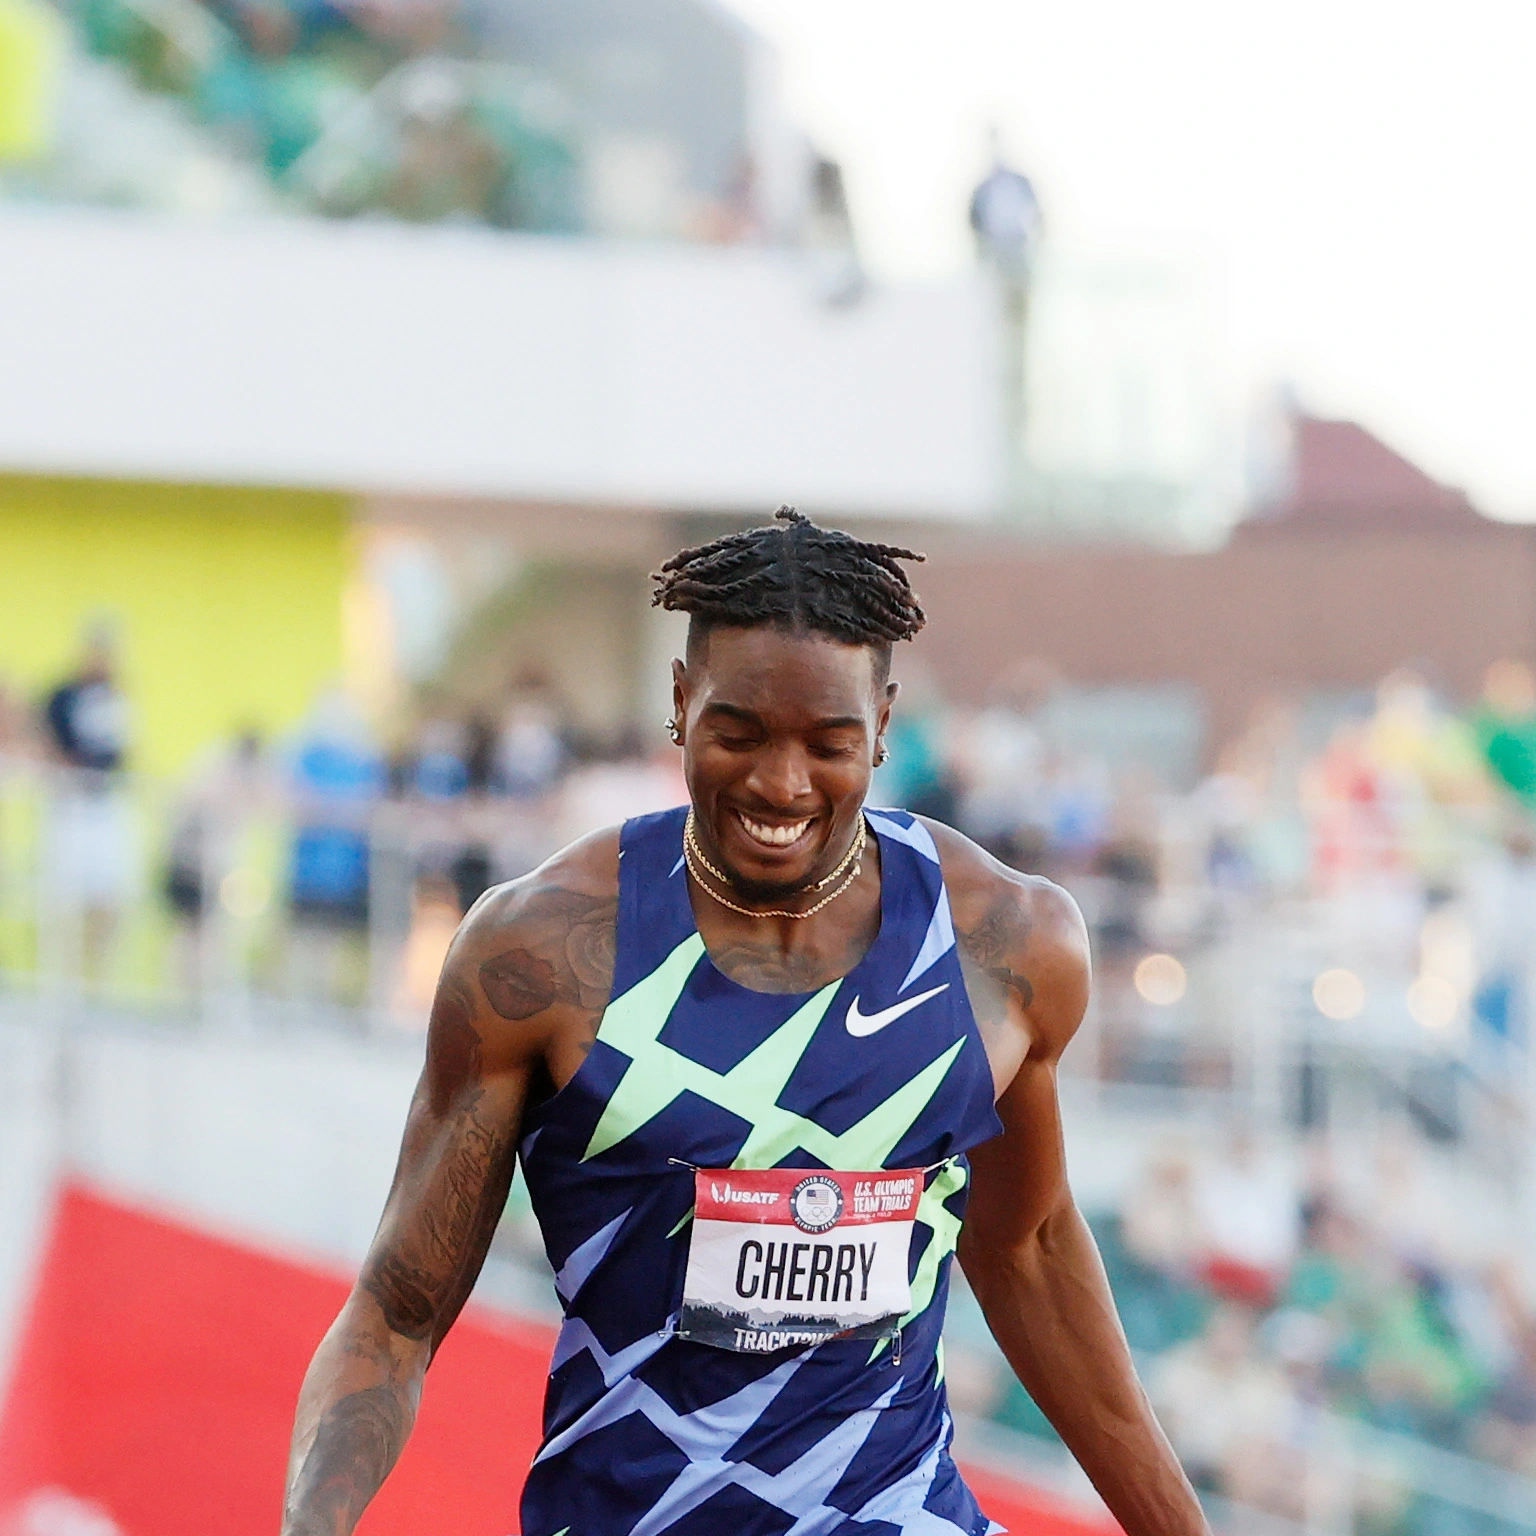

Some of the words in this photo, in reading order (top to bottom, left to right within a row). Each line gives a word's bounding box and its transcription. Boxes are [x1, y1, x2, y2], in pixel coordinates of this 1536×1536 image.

[854, 1181, 873, 1196] U.S.
[874, 1178, 915, 1196] OLYMPIC
[731, 1190, 780, 1205] USATF
[853, 1196, 880, 1213] TEAM
[880, 1194, 912, 1211] TRIALS
[735, 1239, 878, 1302] CHERRY
